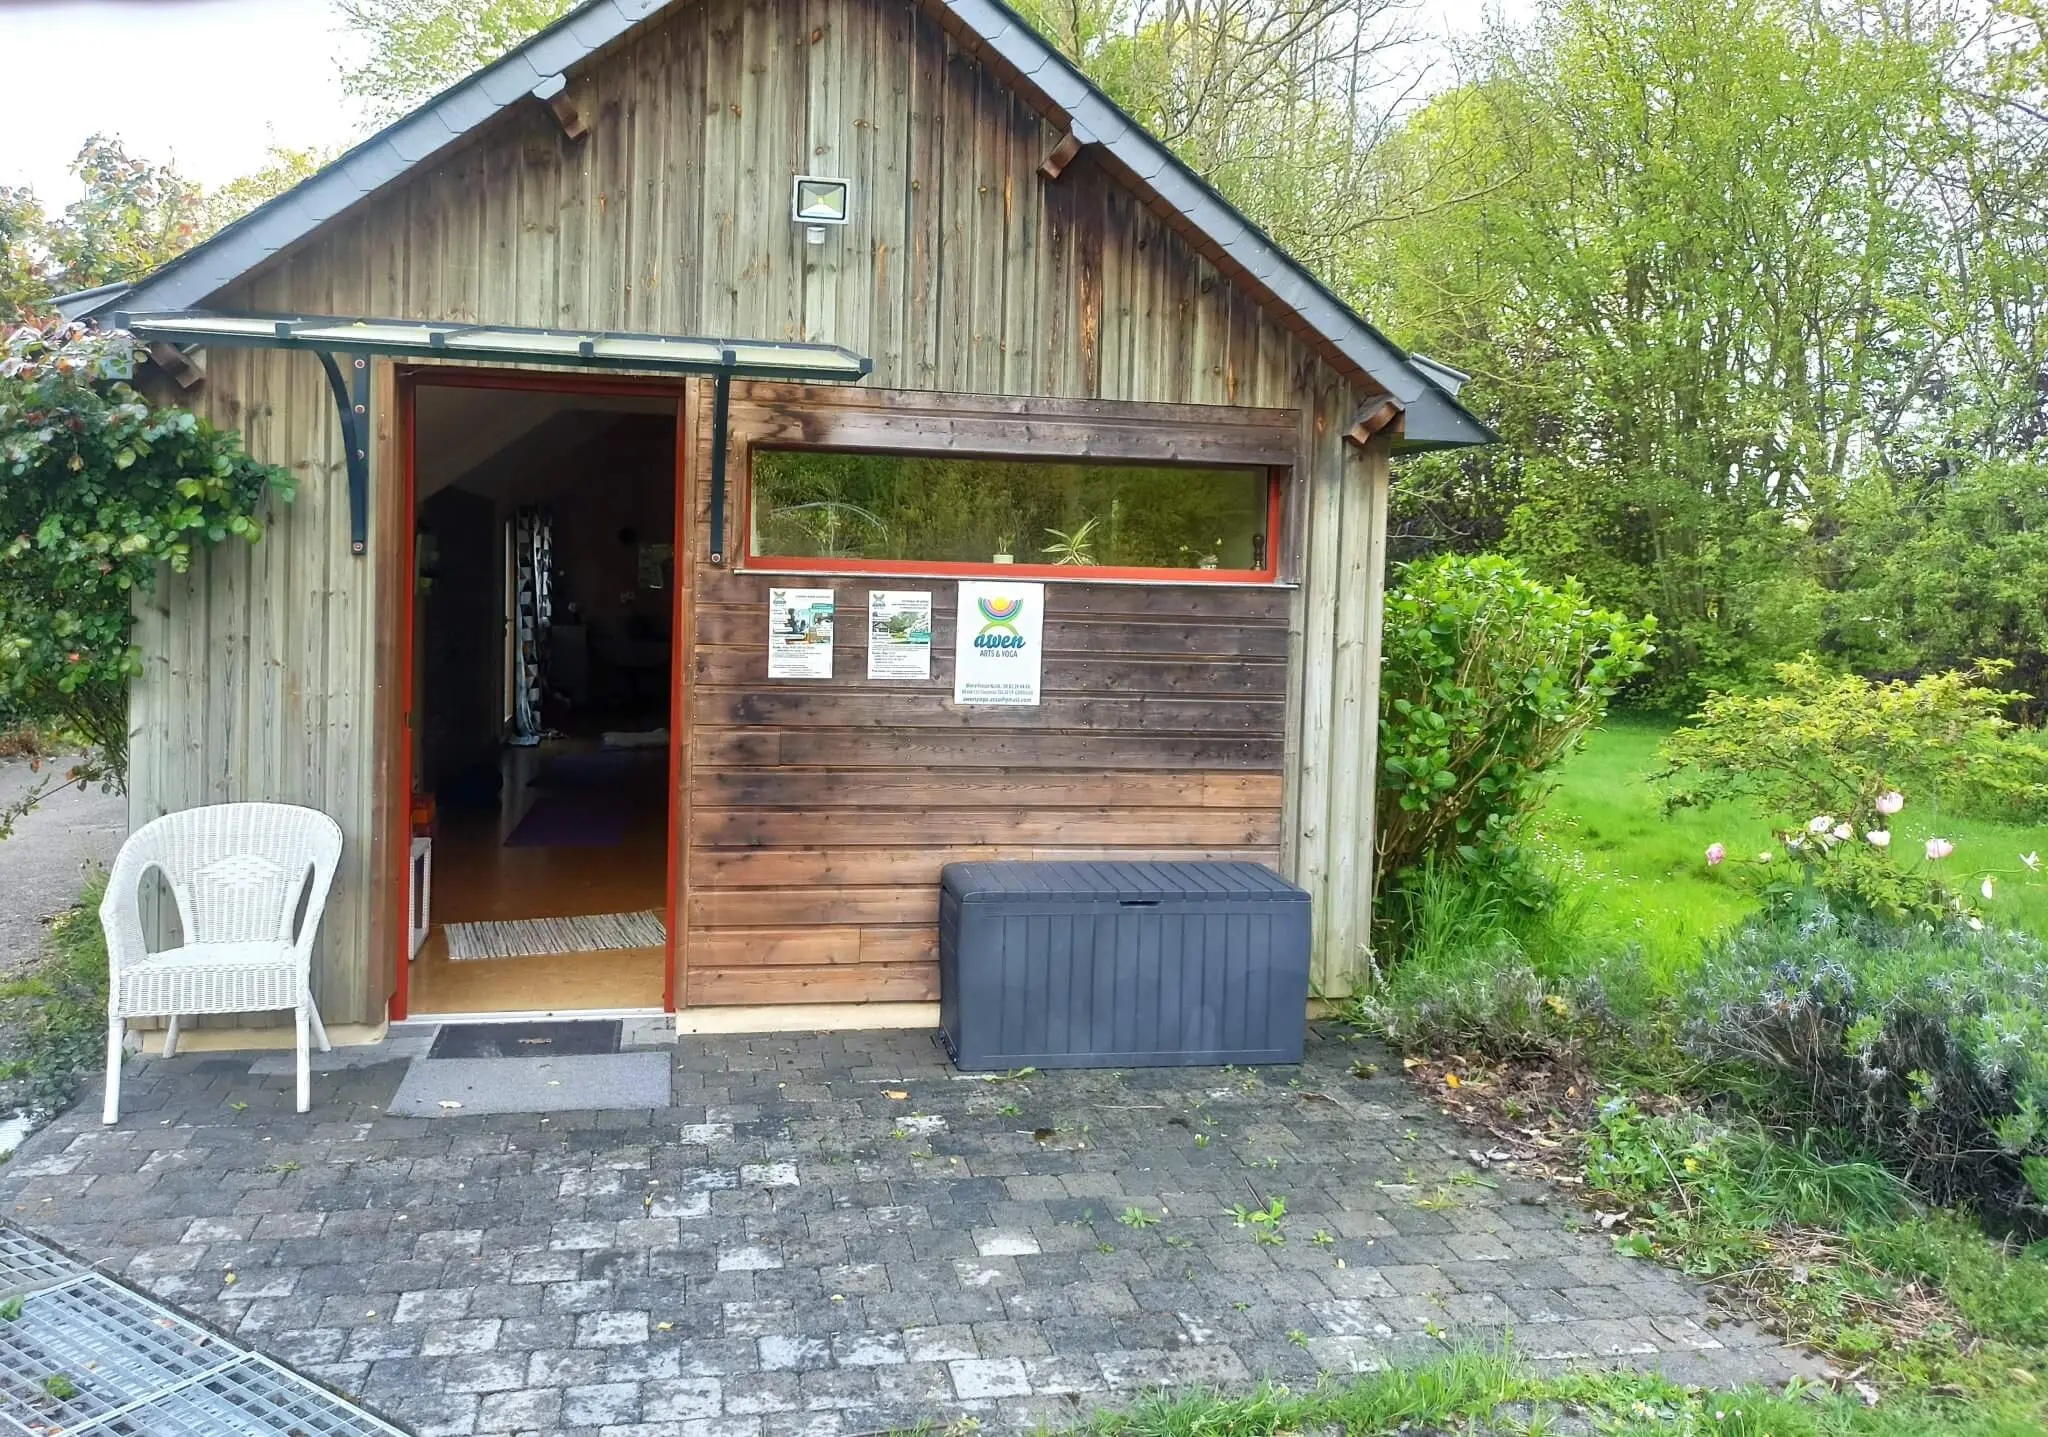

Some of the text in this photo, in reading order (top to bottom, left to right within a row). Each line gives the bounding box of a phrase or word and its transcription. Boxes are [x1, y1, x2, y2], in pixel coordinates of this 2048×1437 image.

[974, 634, 1026, 649] awen
[995, 650, 1001, 658] &
[1002, 650, 1018, 658] YOGA
